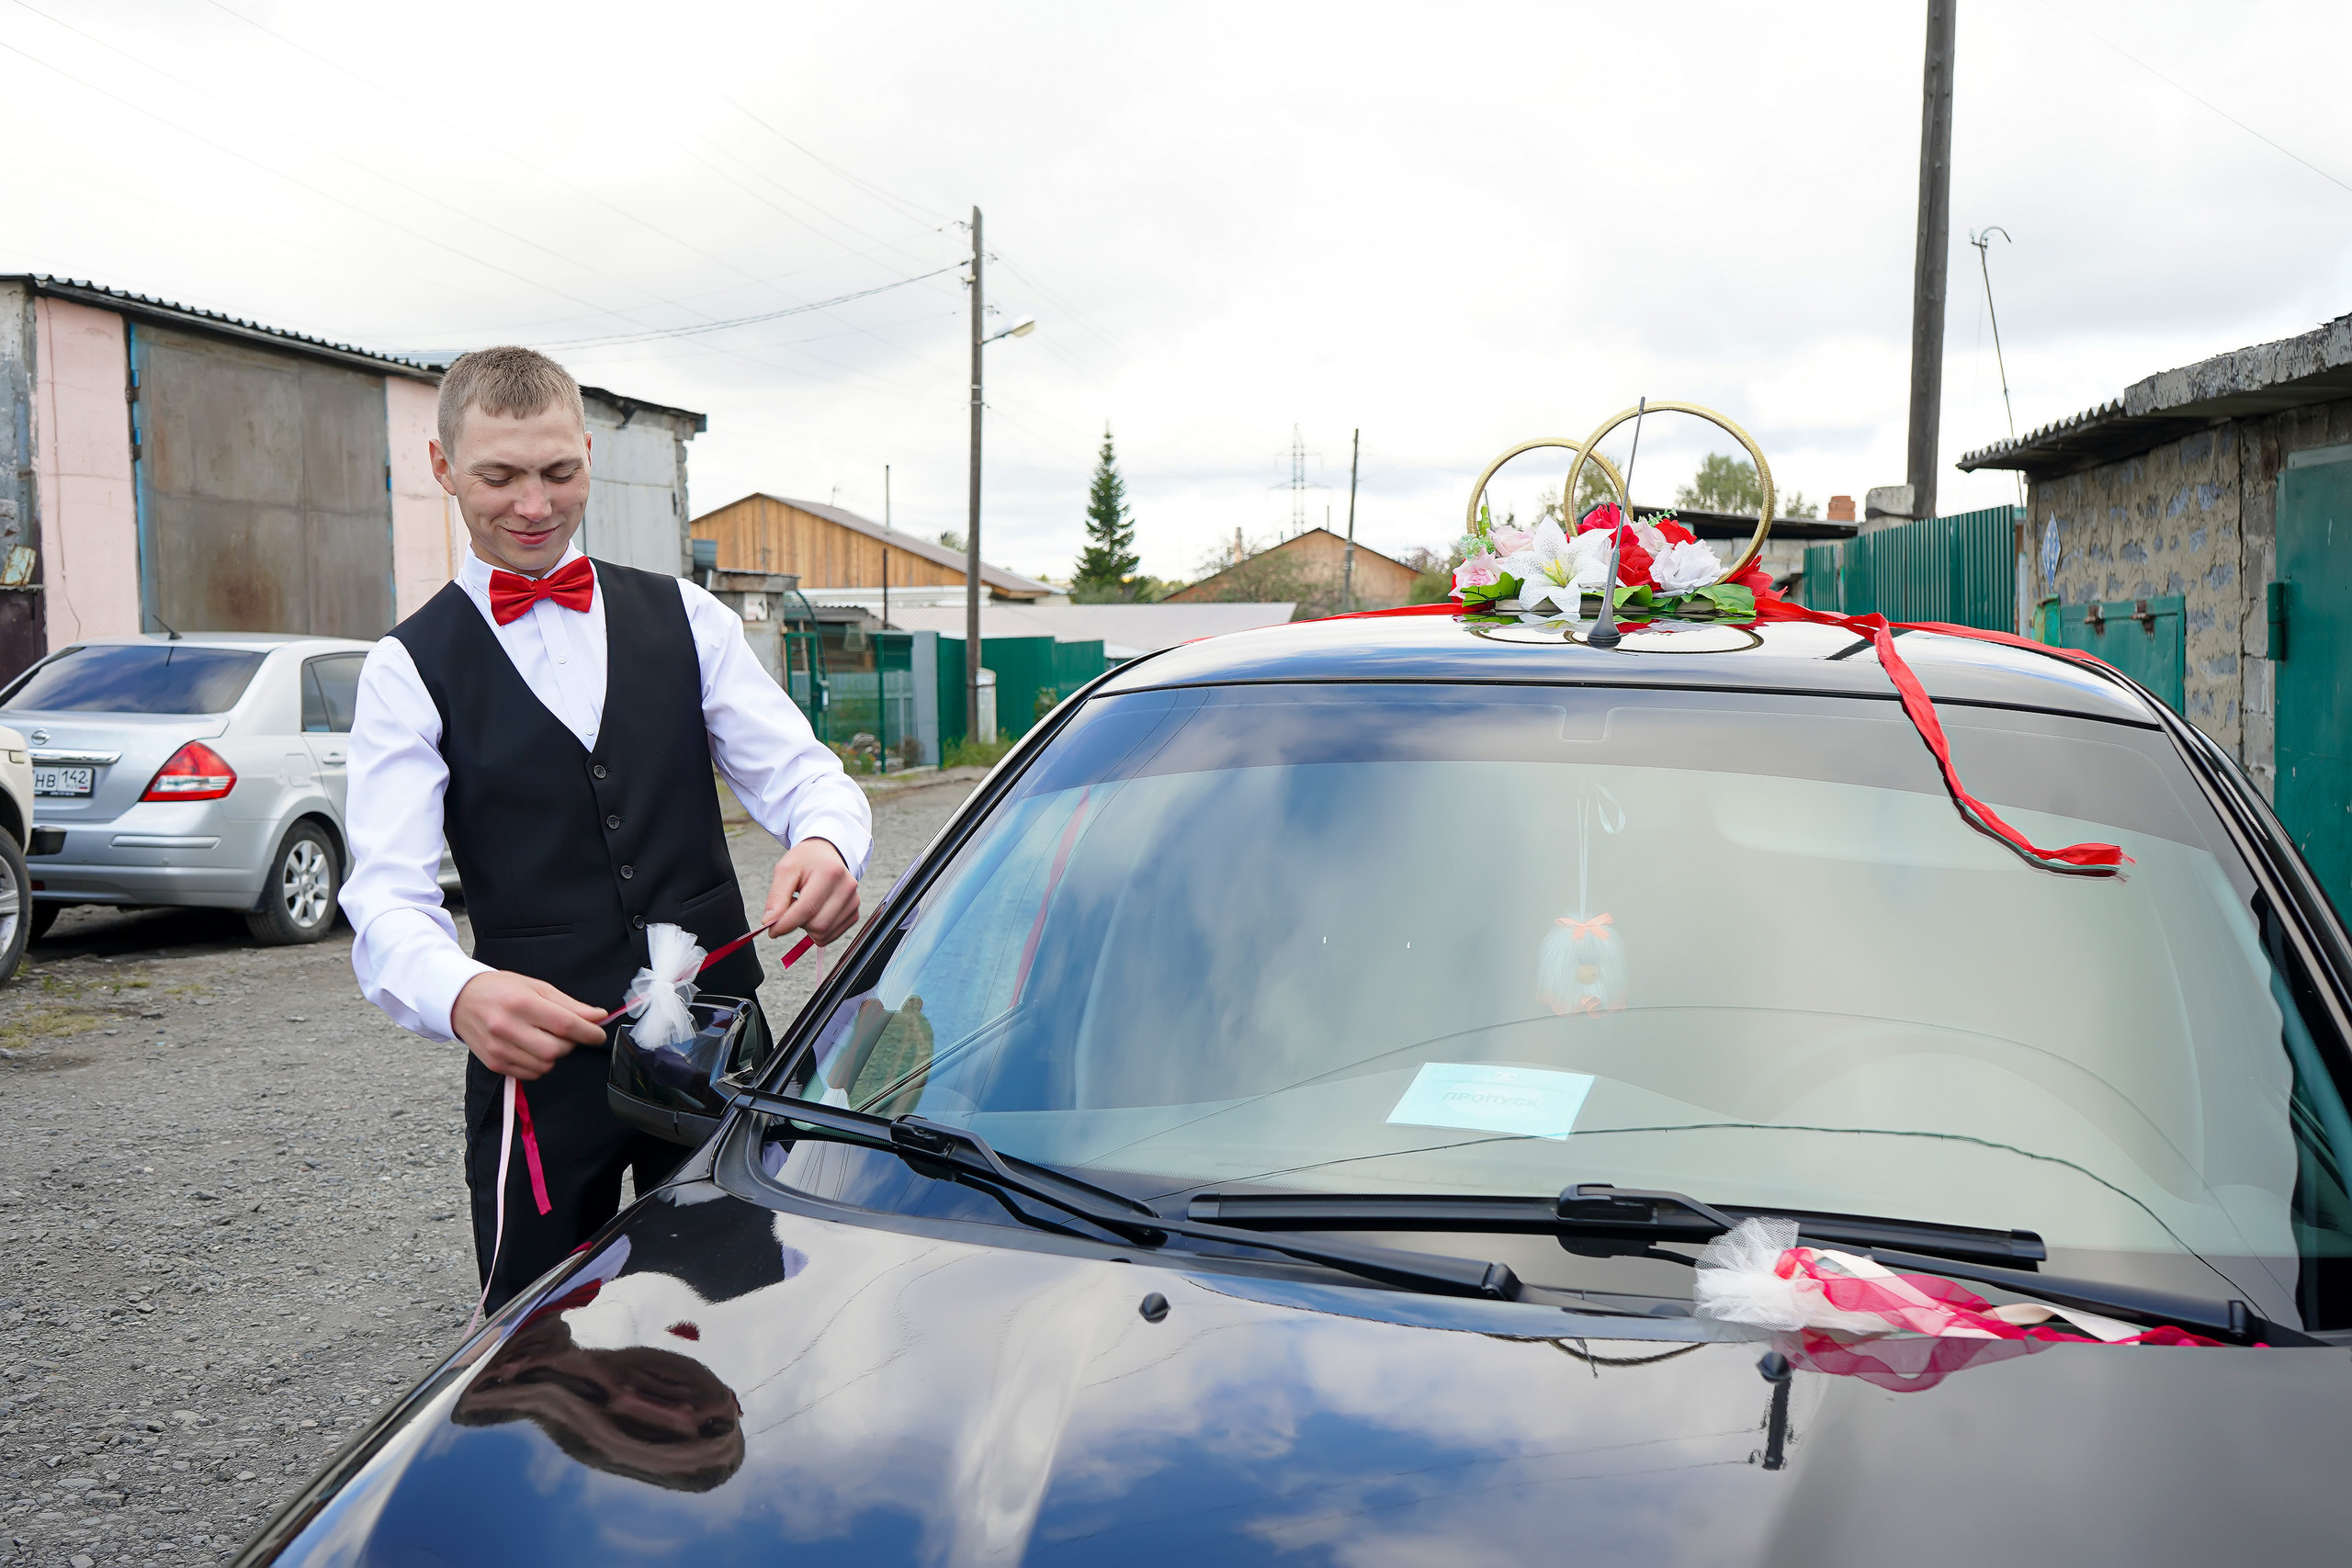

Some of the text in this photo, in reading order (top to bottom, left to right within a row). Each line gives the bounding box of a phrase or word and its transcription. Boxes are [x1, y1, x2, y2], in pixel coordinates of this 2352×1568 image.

[33, 771, 86, 787] НВ 142
[1442, 1092, 1539, 1107] ПРОПУСК
